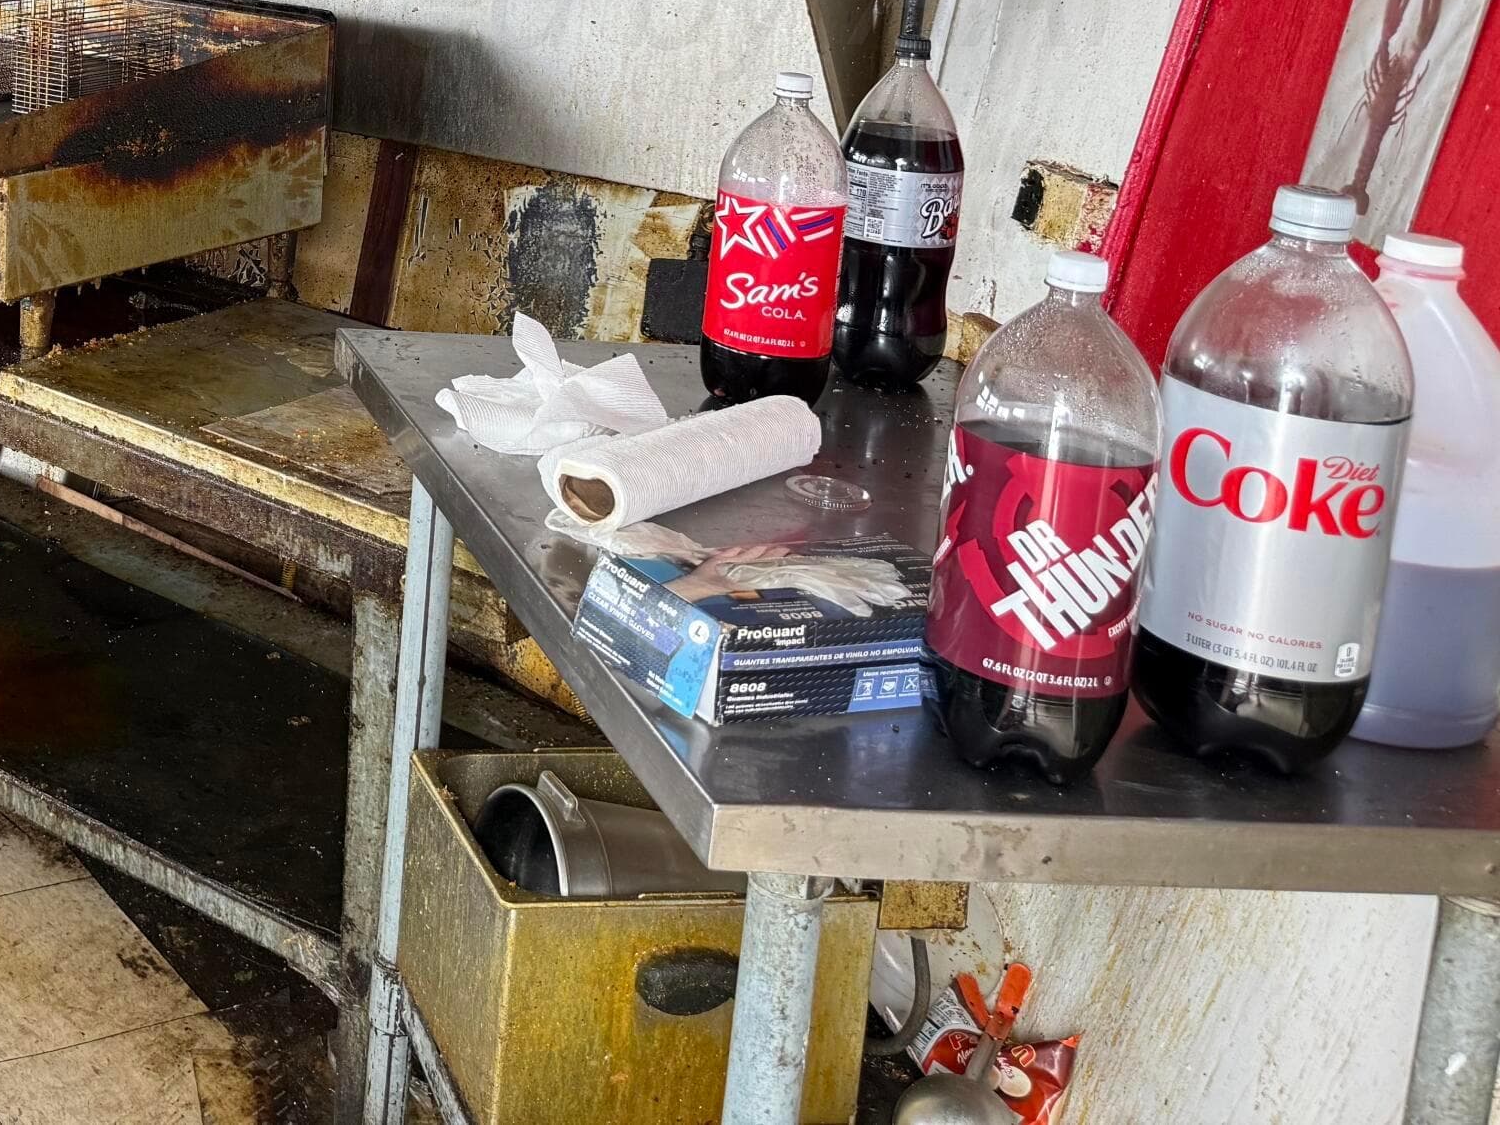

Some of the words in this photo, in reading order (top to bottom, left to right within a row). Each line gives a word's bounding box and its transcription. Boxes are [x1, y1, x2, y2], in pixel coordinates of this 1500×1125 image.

[920, 193, 960, 238] Bar
[720, 271, 820, 309] Sam's
[761, 306, 804, 320] COLA
[1169, 427, 1386, 539] Coke
[1322, 455, 1381, 481] Diet
[1006, 518, 1072, 574] DR
[600, 556, 649, 593] ProGuard
[628, 618, 655, 641] GLOVES
[695, 626, 702, 637] L
[737, 625, 805, 640] ProGuard
[1187, 611, 1203, 623] NO
[1205, 618, 1243, 635] SUGAR
[1248, 631, 1264, 640] NO
[1268, 635, 1324, 649] CALORIES
[733, 657, 770, 666] GUANTES
[772, 653, 832, 664] TRANSPARENTES
[845, 650, 868, 659] VINILO
[870, 649, 881, 657] NO
[882, 646, 922, 656] EMPOLVAD
[1191, 635, 1211, 649] LITER
[1212, 642, 1222, 653] (3
[1222, 645, 1234, 657] QT
[1234, 649, 1248, 661] 5.4
[1260, 655, 1275, 667] OZ)
[1277, 658, 1296, 671] 101.4
[1297, 661, 1306, 672] FL
[1307, 663, 1318, 673] OZ
[729, 683, 767, 693] 8608
[982, 657, 1002, 672] 67.6
[1002, 662, 1013, 676] FL
[1013, 665, 1025, 678] OZ
[1025, 667, 1036, 682] (2
[1036, 670, 1048, 684] QT
[1048, 673, 1063, 686] 3.6
[1064, 674, 1074, 687] FL
[1074, 675, 1088, 689] OZ)
